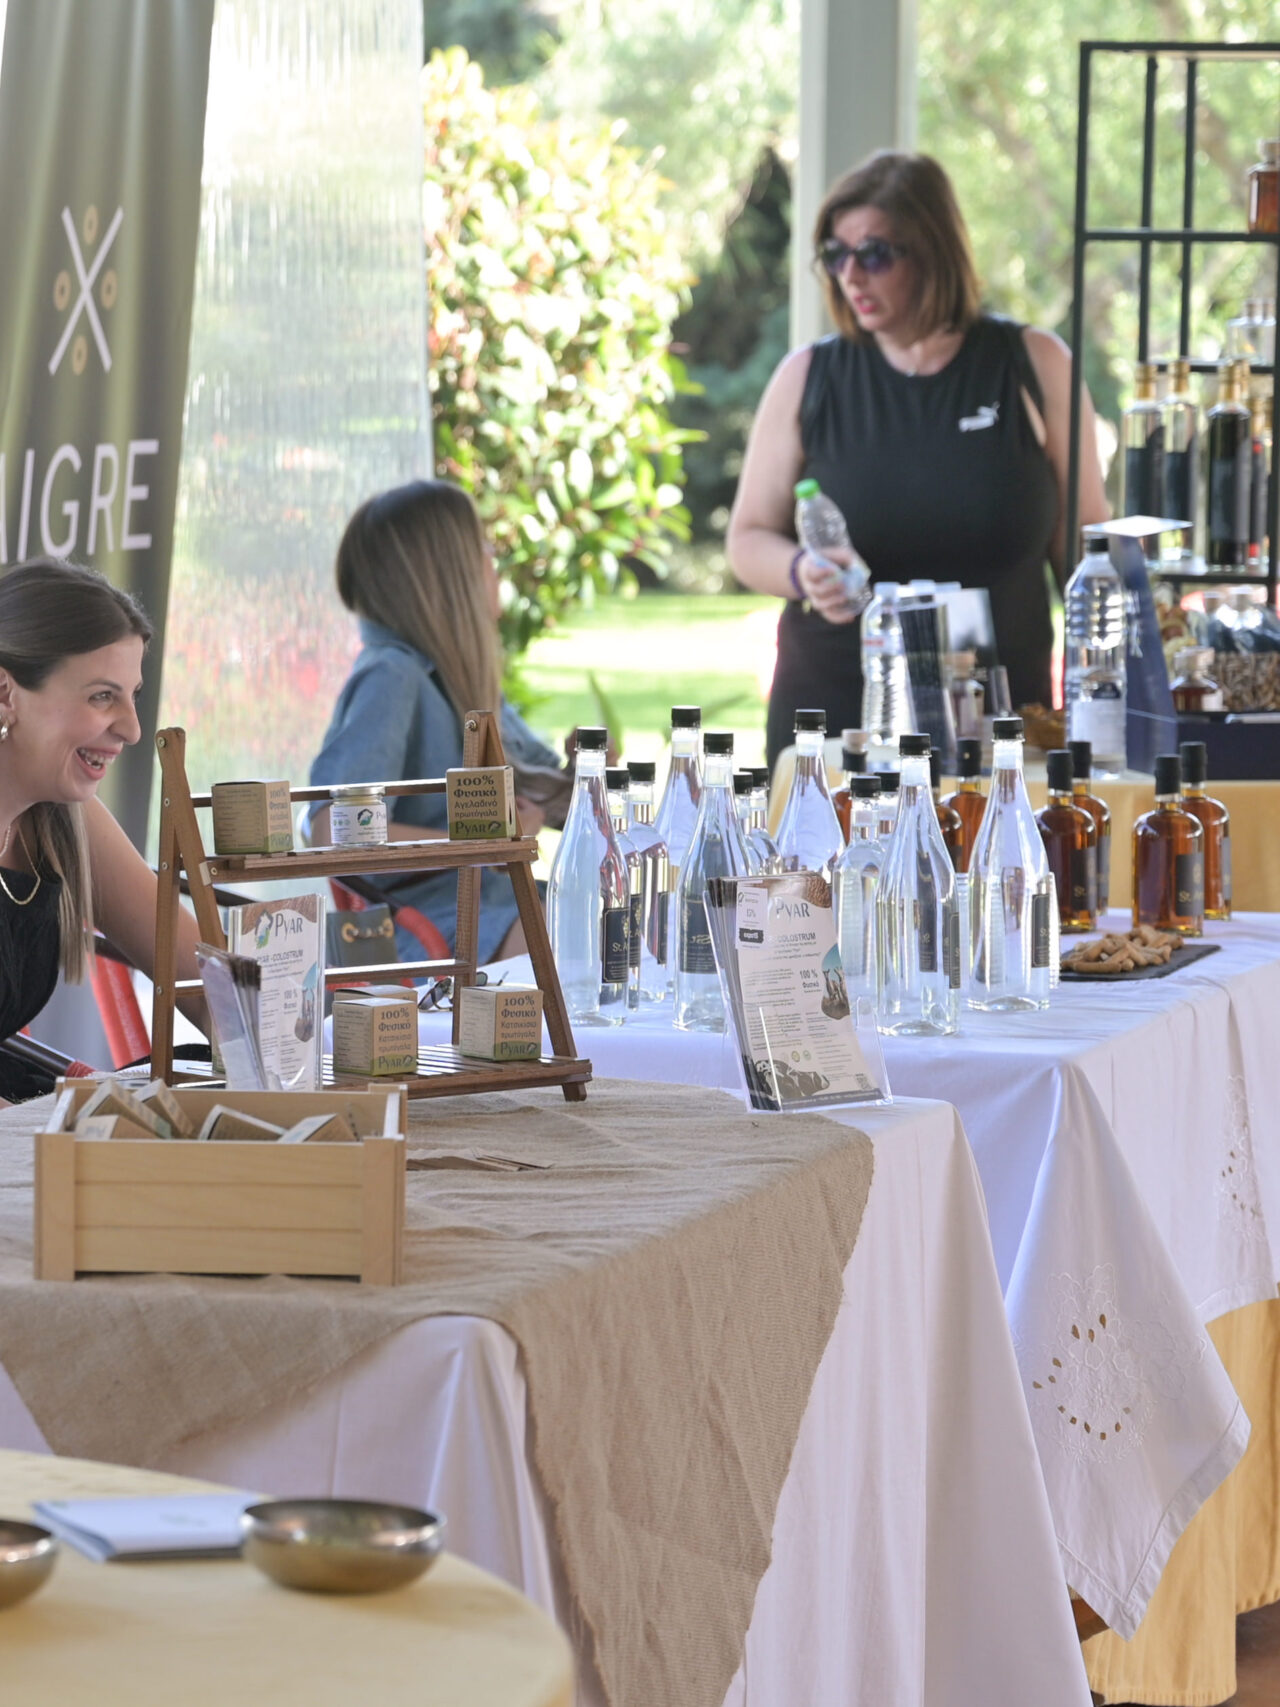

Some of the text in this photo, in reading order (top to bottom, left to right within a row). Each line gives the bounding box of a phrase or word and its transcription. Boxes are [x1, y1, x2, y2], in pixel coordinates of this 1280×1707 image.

[457, 774, 495, 787] 100%
[453, 787, 497, 798] Φυσικό
[454, 800, 498, 810] Αγελαδινό
[455, 808, 498, 818] πρωτόγαλα
[504, 995, 535, 1006] 100%
[381, 1007, 410, 1020] 100%
[501, 1007, 536, 1017] Φυσικό
[378, 1019, 411, 1031] Φυσικό
